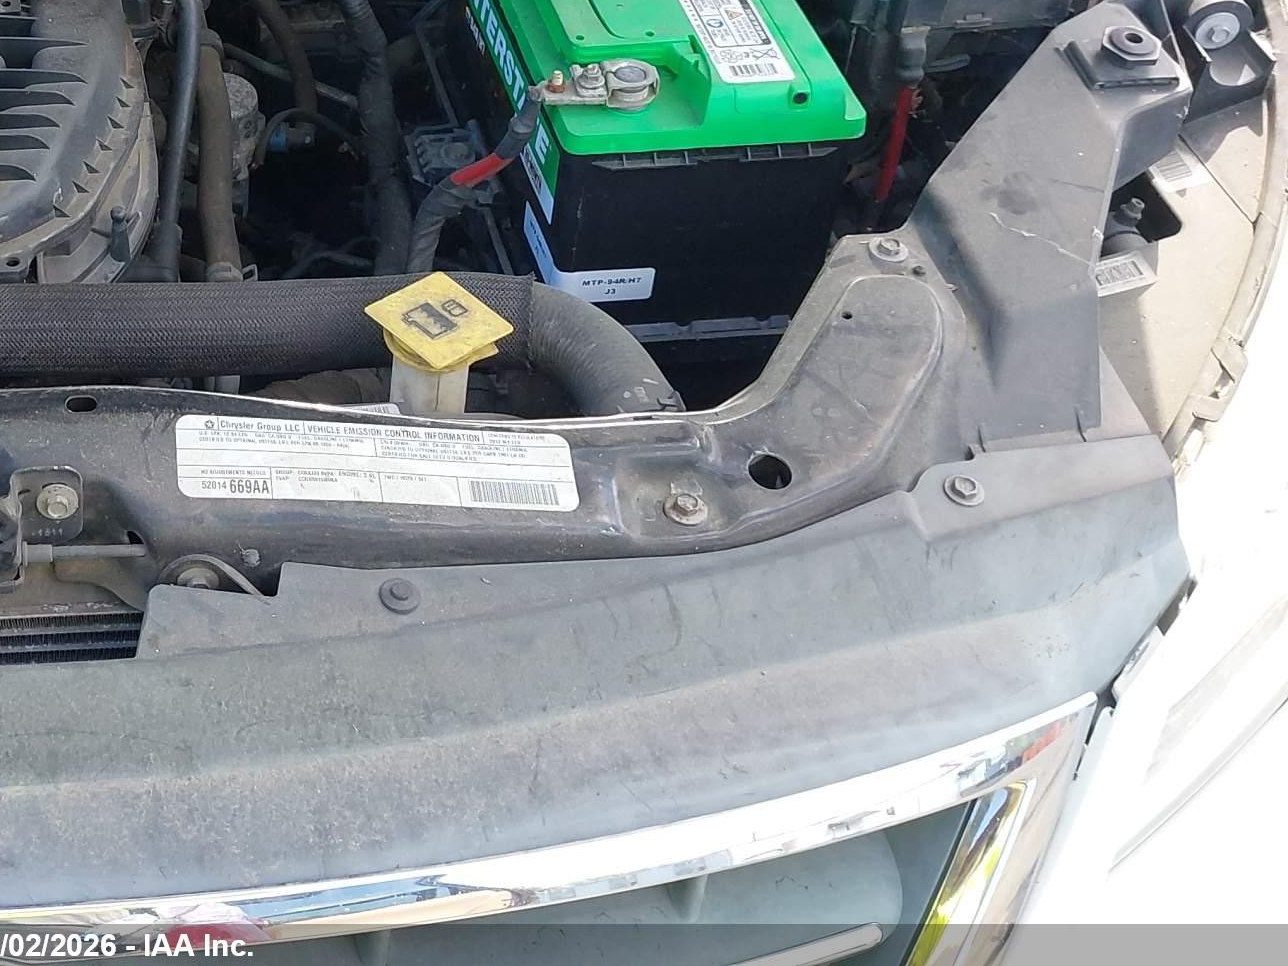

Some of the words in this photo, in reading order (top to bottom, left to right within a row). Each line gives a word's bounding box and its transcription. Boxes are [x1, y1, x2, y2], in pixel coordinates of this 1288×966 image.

[220, 420, 254, 432] Chrysler
[257, 421, 282, 432] Group
[284, 423, 300, 432] LLC
[307, 425, 341, 435] VEHICLE
[344, 426, 381, 437] EMISSION
[384, 429, 421, 440] CONTROL
[424, 430, 480, 443] INFORMATION
[201, 480, 227, 490] 52014
[229, 479, 270, 494] 669AA
